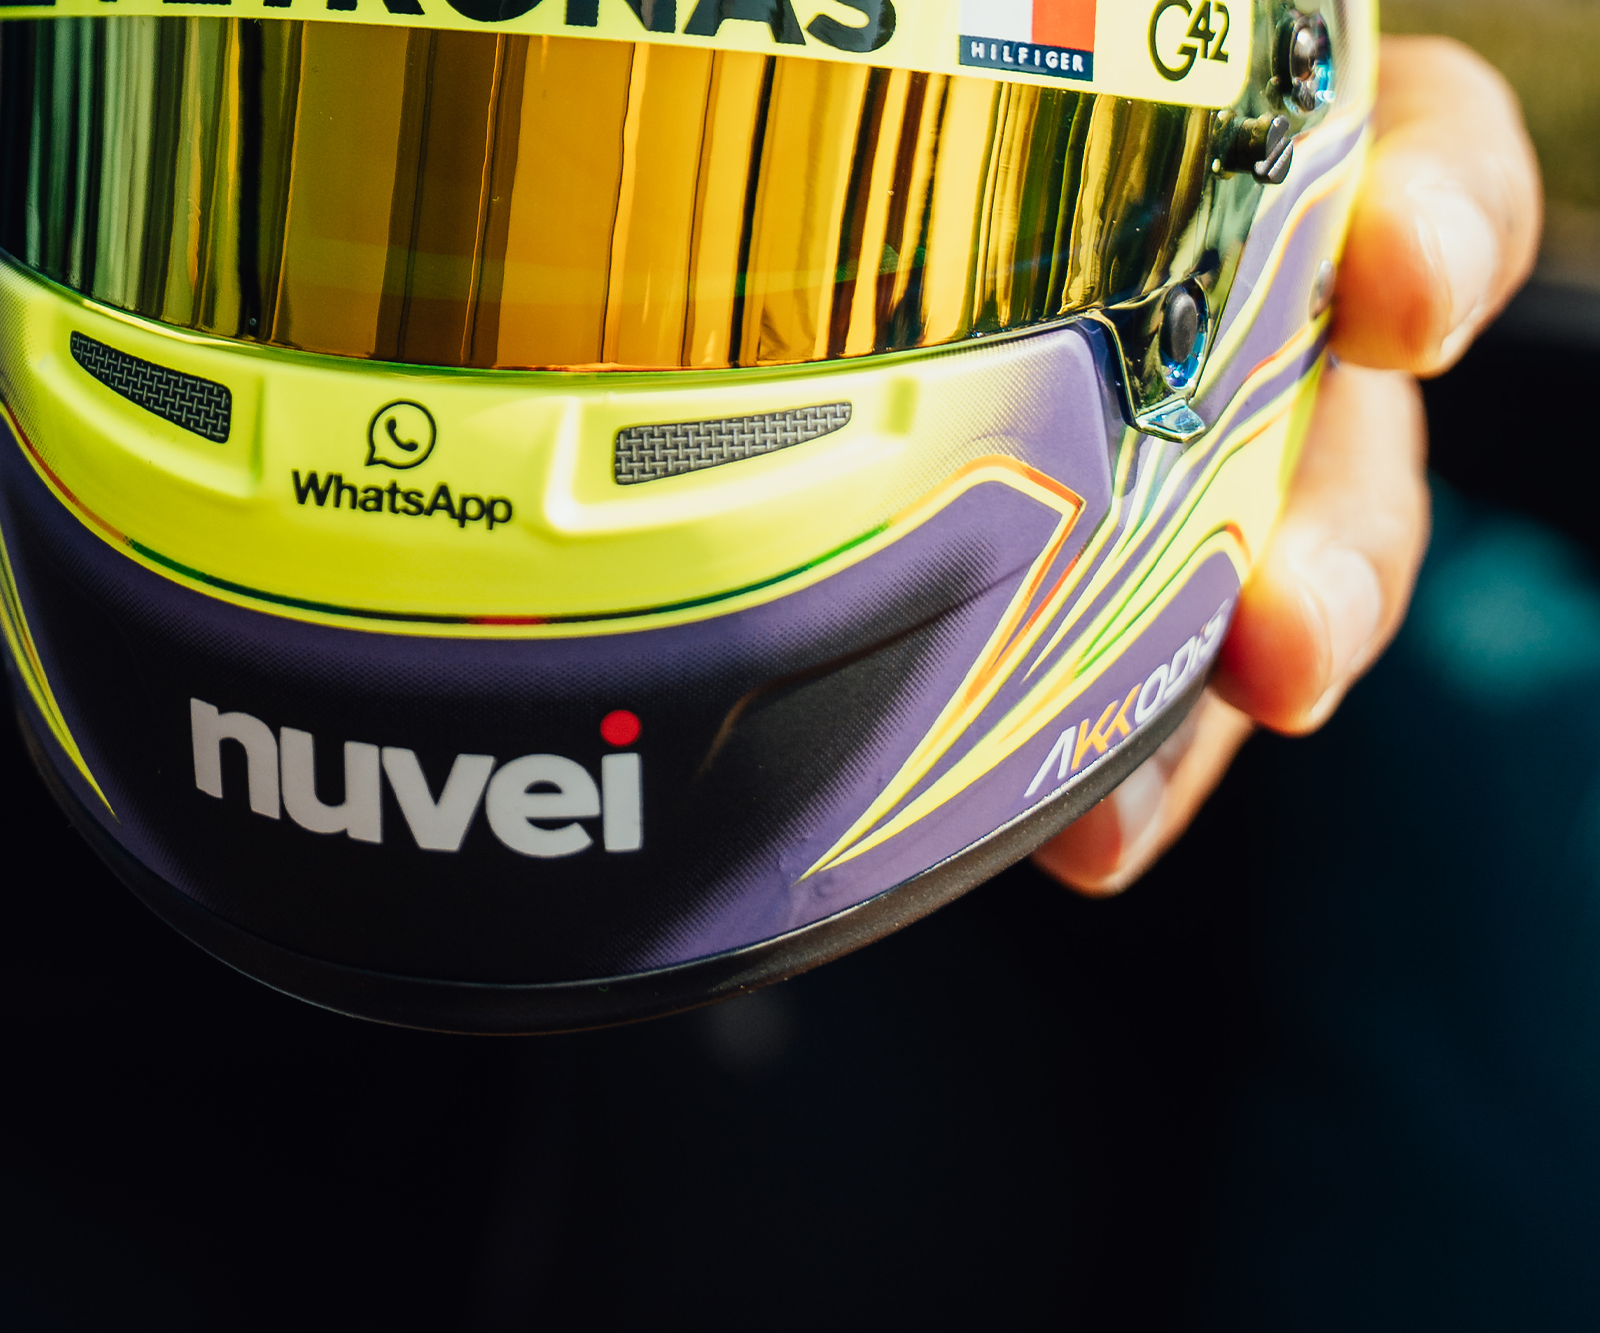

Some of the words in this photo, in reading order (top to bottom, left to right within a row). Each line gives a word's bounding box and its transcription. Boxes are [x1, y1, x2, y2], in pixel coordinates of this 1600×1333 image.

[970, 40, 1085, 73] HILFIGER
[291, 469, 514, 530] WhatsApp
[189, 696, 644, 859] nuvei
